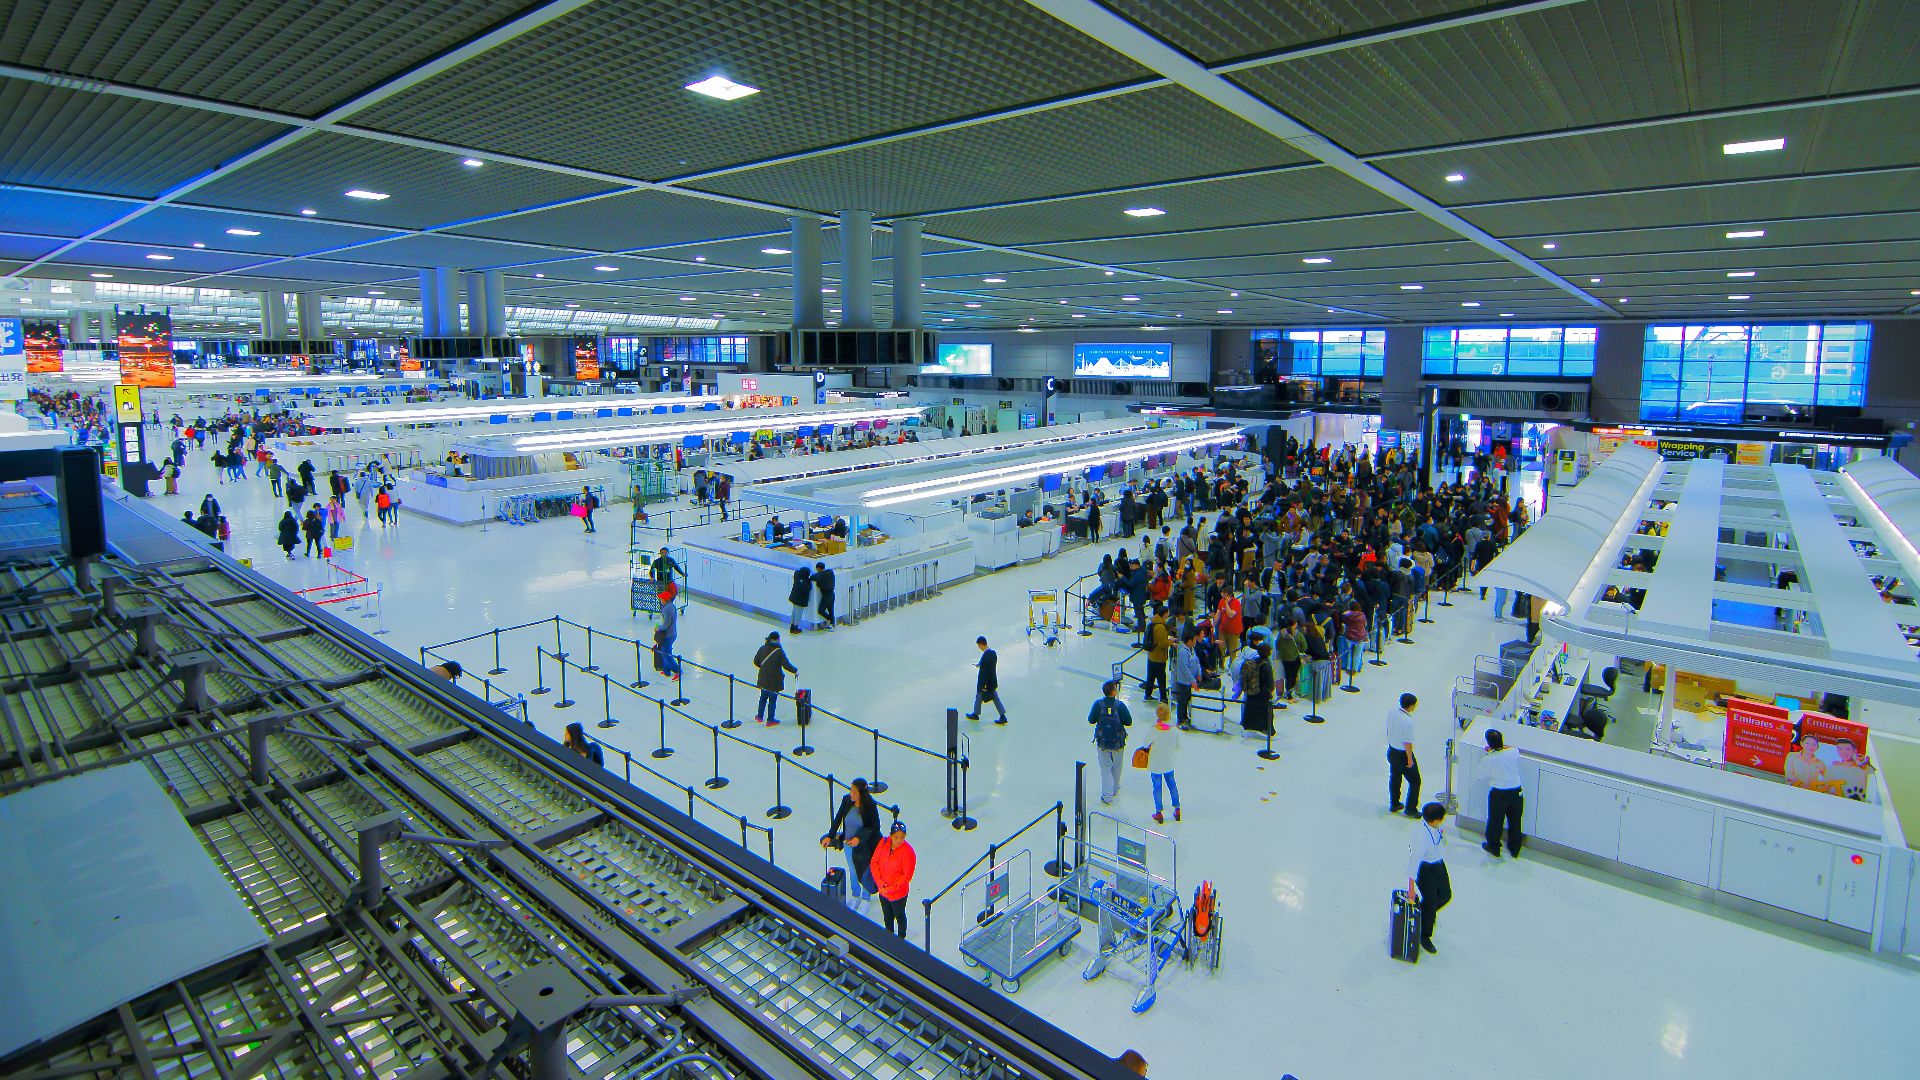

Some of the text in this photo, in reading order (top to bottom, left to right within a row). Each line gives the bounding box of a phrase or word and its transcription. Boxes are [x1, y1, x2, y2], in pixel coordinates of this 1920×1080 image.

[502, 363, 510, 371] H
[663, 367, 669, 377] E
[816, 372, 825, 383] D
[1047, 378, 1054, 391] C
[1660, 441, 1705, 452] Wrapping
[1661, 448, 1696, 457] Service
[1733, 713, 1775, 729] Emirates
[1806, 717, 1849, 732] Emirates
